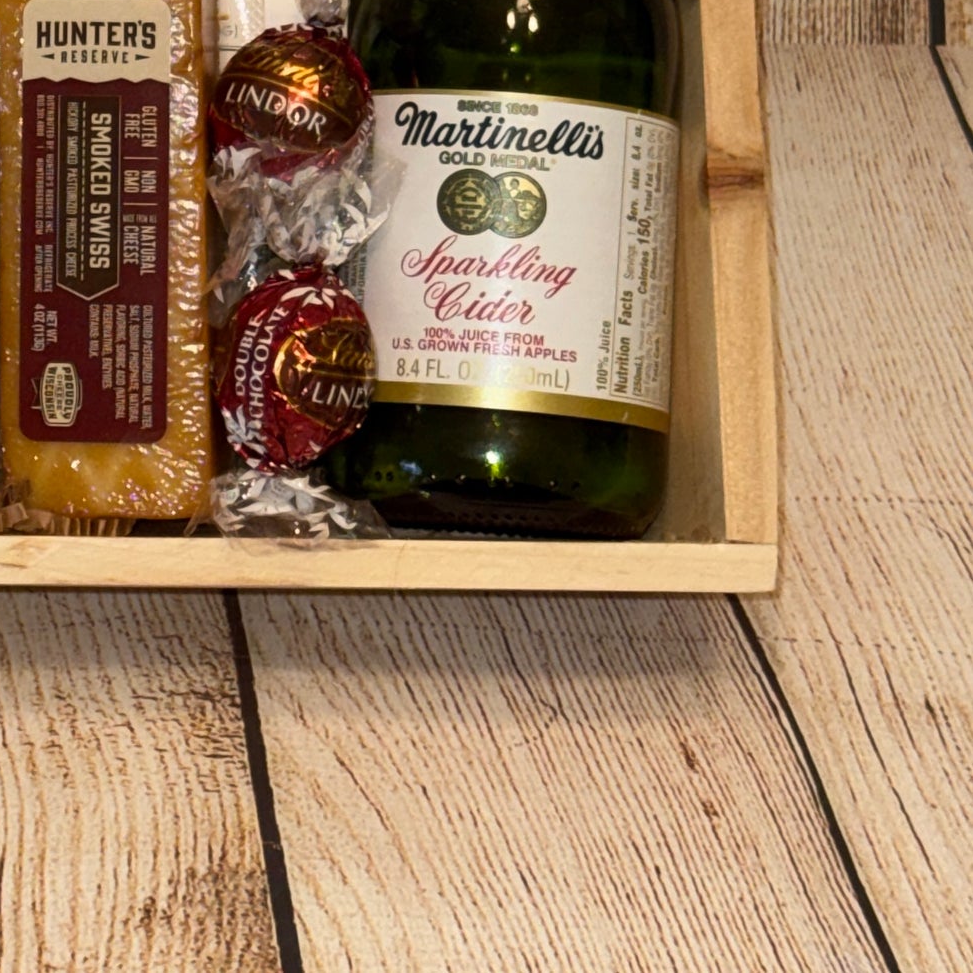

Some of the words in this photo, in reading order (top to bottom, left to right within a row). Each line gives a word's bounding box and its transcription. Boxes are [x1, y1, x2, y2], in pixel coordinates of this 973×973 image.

[36, 20, 156, 49] HUNTER'S
[61, 50, 129, 64] RESERVE
[67, 102, 78, 132] HICKORY
[124, 113, 140, 139] FREE
[141, 106, 157, 147] GLUTEN
[225, 82, 327, 140] LINDOR
[395, 101, 604, 160] Martinelli's
[67, 136, 78, 164] SMOKED
[90, 113, 112, 195] SMOKED
[439, 151, 486, 166] GOLD
[124, 170, 140, 193] GMO
[141, 170, 157, 193] NON
[66, 217, 77, 248] PROCESS
[89, 202, 111, 268] SWISS
[123, 225, 139, 264] CHEESE
[637, 215, 652, 245] 150,
[66, 252, 77, 277] CHEESE
[140, 226, 156, 276] NATURAL
[400, 234, 578, 299] Sparkling
[637, 251, 649, 295] Calories
[34, 311, 45, 323] OZ
[46, 310, 58, 327] NET
[424, 281, 535, 325] Cider
[618, 290, 633, 326] Facts
[392, 337, 414, 350] U.S.
[418, 338, 470, 353] GROWN
[474, 342, 520, 357] FRESH
[524, 347, 578, 363] APPLES
[423, 326, 455, 340] 100%
[458, 329, 500, 342] JUICE
[504, 332, 545, 346] FROM
[599, 320, 611, 353] Juice
[234, 316, 263, 396] DOUBLE
[250, 305, 289, 420] CHOCOLATE
[396, 357, 420, 377] 8.4
[425, 358, 451, 379] FL.
[614, 337, 630, 394] Nutrition
[596, 357, 609, 391] 100%
[45, 367, 58, 420] WISCONSIN
[62, 367, 74, 420] PROUDLY
